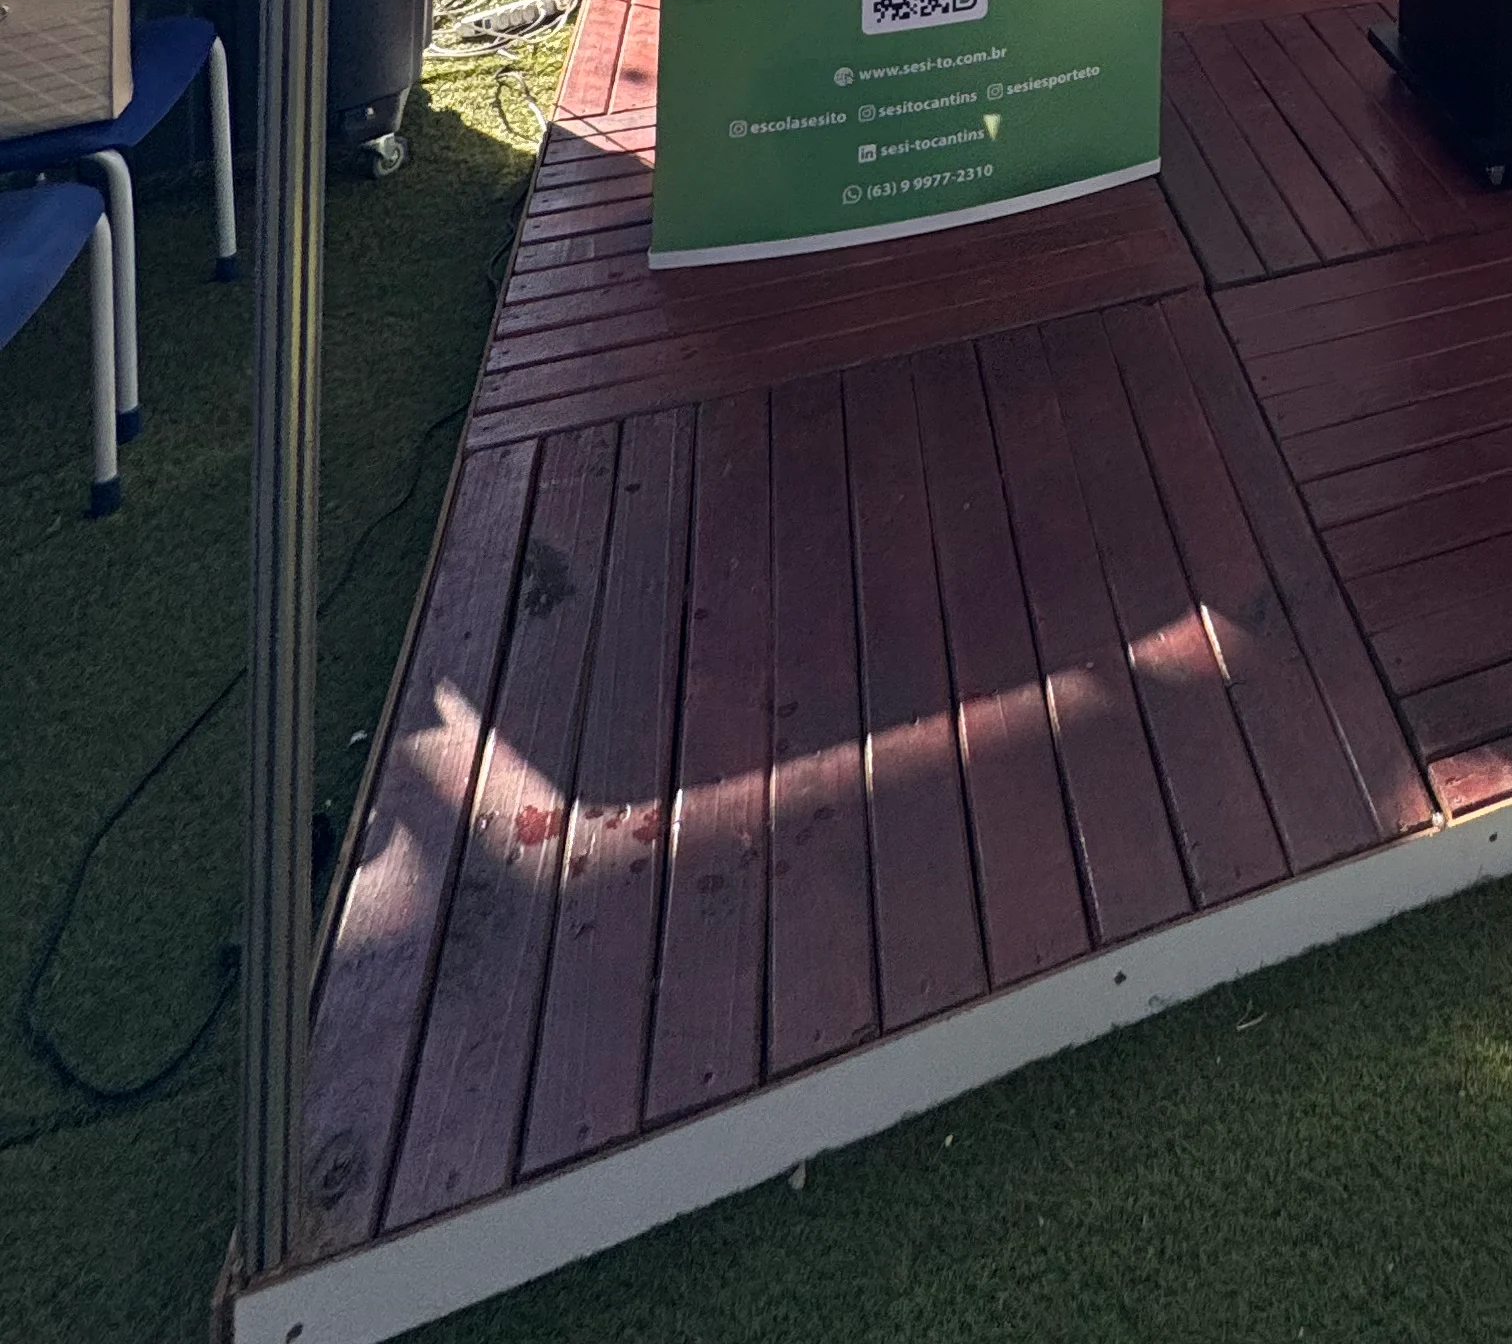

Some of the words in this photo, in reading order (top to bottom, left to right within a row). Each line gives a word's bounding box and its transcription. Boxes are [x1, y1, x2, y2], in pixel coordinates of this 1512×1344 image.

[858, 46, 1008, 82] www.sesi-to.com.br
[750, 111, 848, 135] escolasesito
[878, 90, 978, 119] sesitocantins
[1006, 64, 1101, 96] sesiesporteto
[879, 127, 986, 158] sesi-tocantins
[866, 181, 898, 200] (63)
[900, 179, 909, 193] 9
[911, 164, 994, 192] 9977-2310
